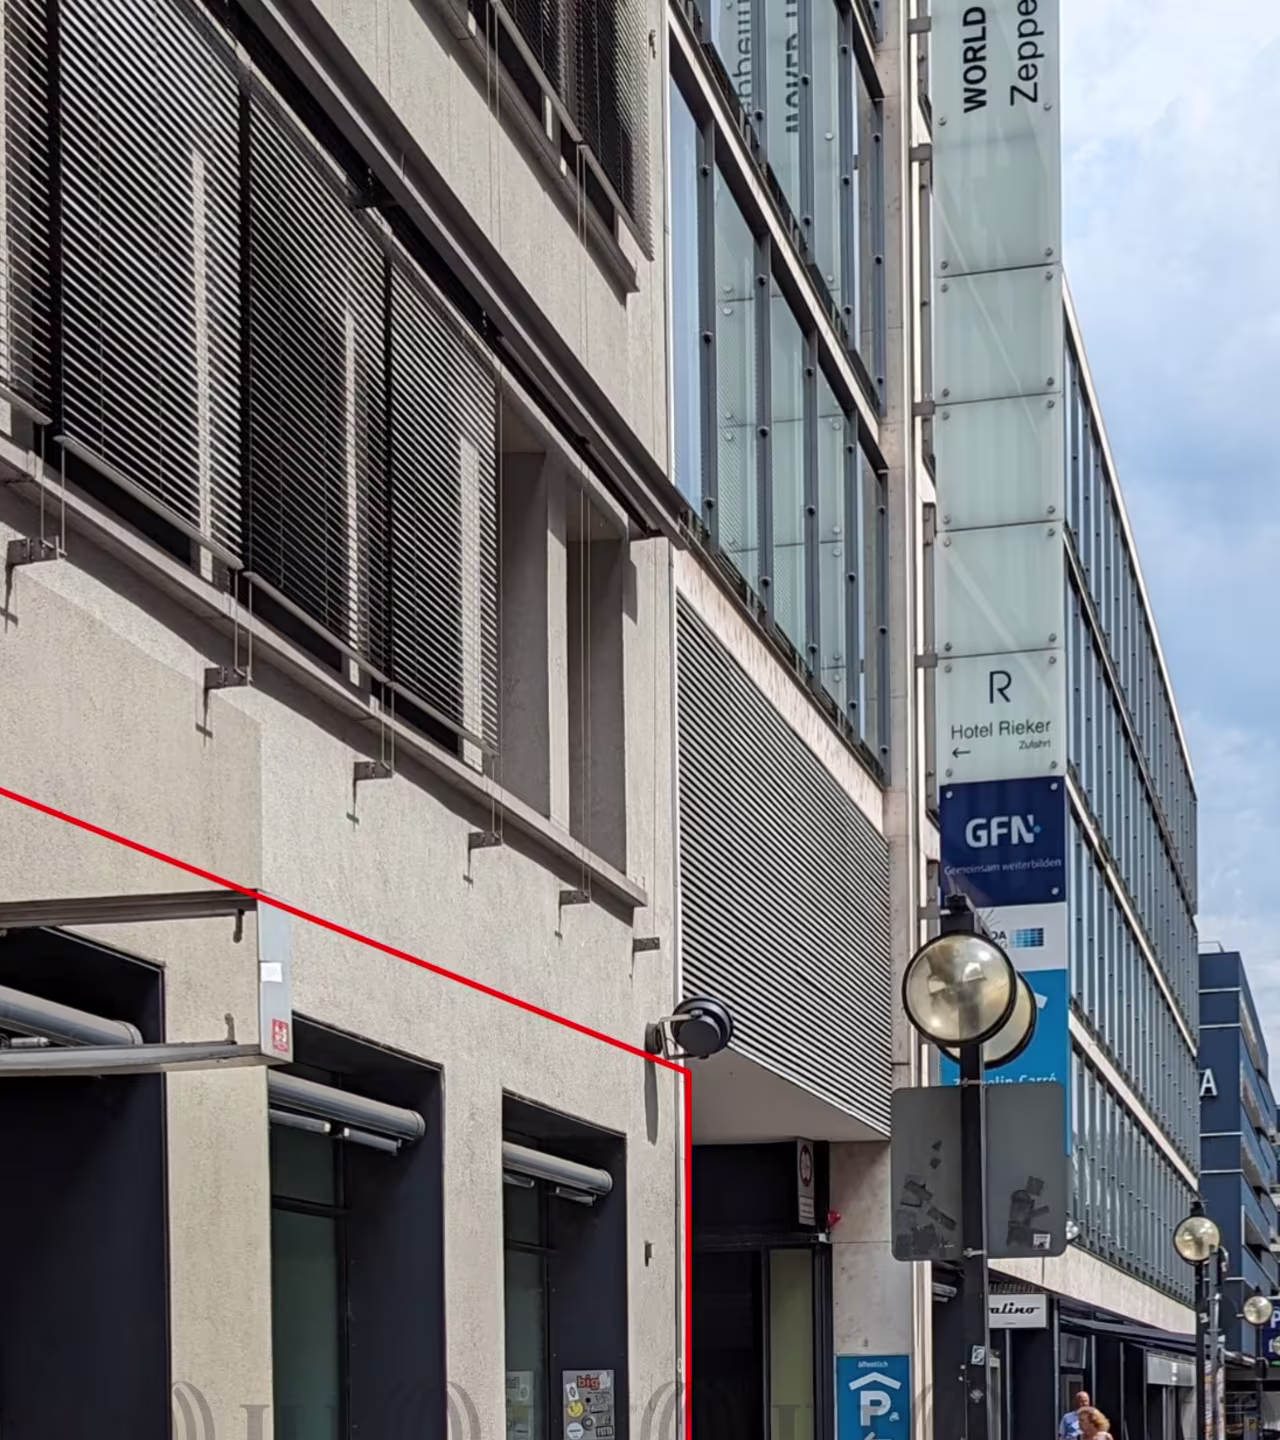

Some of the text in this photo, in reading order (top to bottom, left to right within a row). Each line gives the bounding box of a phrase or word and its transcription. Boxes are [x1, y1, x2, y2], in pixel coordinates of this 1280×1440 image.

[962, 6, 987, 113] WORLD
[989, 670, 1012, 704] R
[951, 719, 1051, 740] Hotel Rieker
[965, 814, 1035, 848] GFN
[944, 857, 1062, 876] Gemeinsam weiterbilden
[988, 1301, 1041, 1315] alino
[860, 1390, 892, 1427] P
